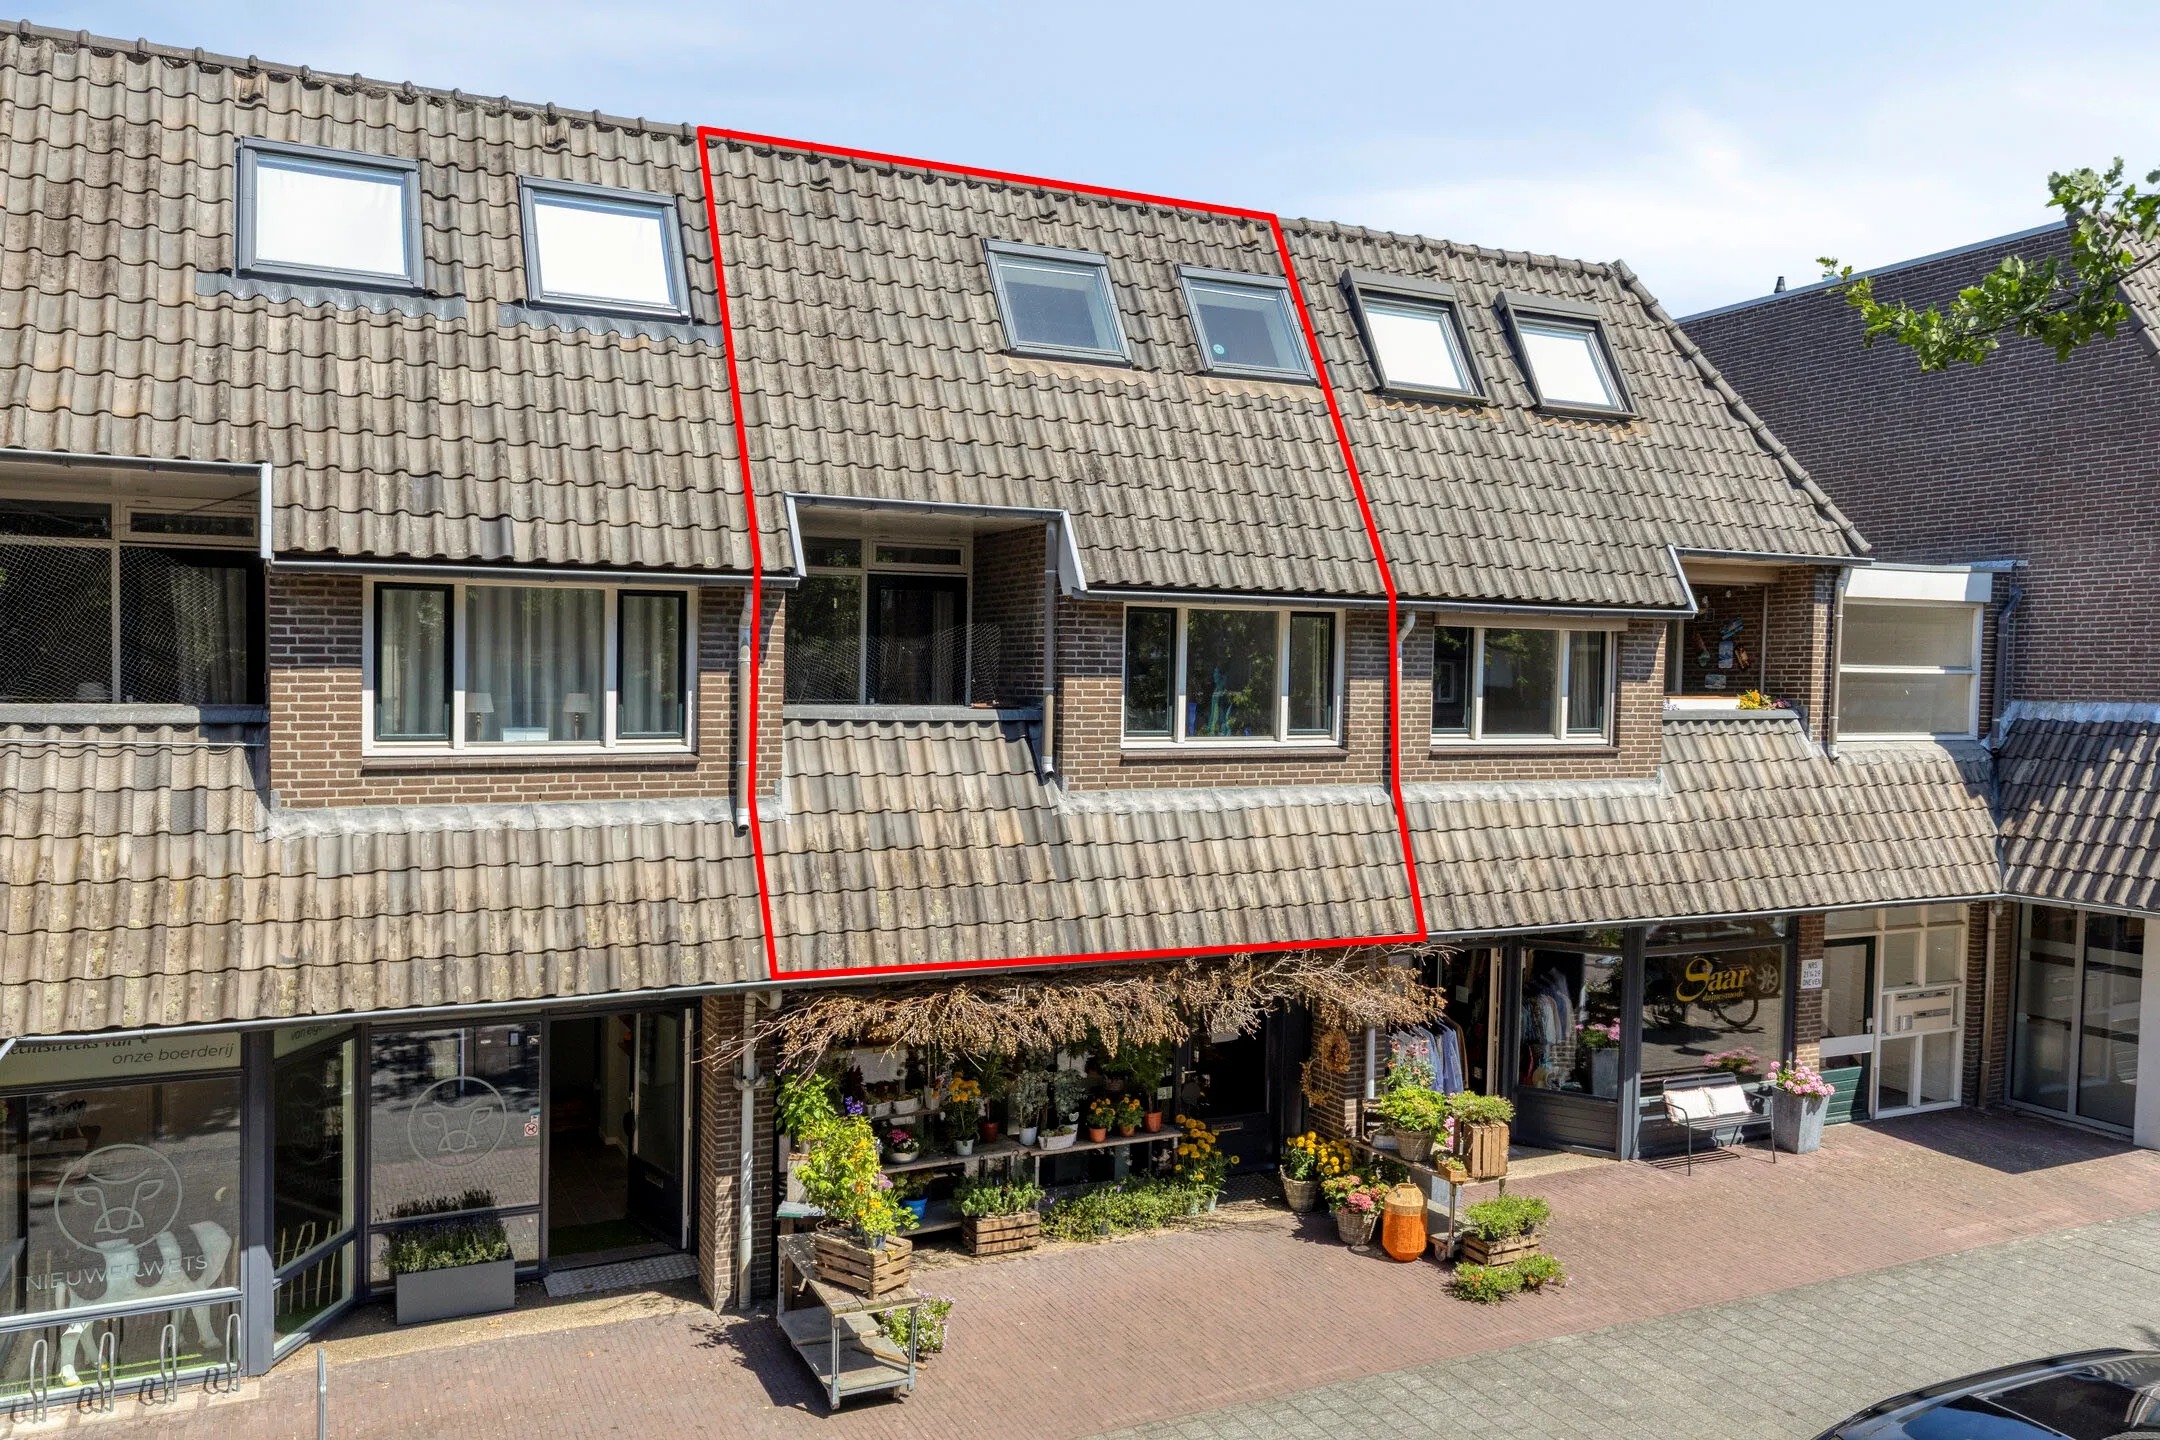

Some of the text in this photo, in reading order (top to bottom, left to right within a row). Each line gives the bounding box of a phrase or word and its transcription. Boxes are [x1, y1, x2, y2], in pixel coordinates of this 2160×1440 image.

[1676, 957, 1751, 1002] Saar
[112, 1043, 235, 1065] onze boerderij
[26, 1256, 208, 1292] NIEUWERWETS
